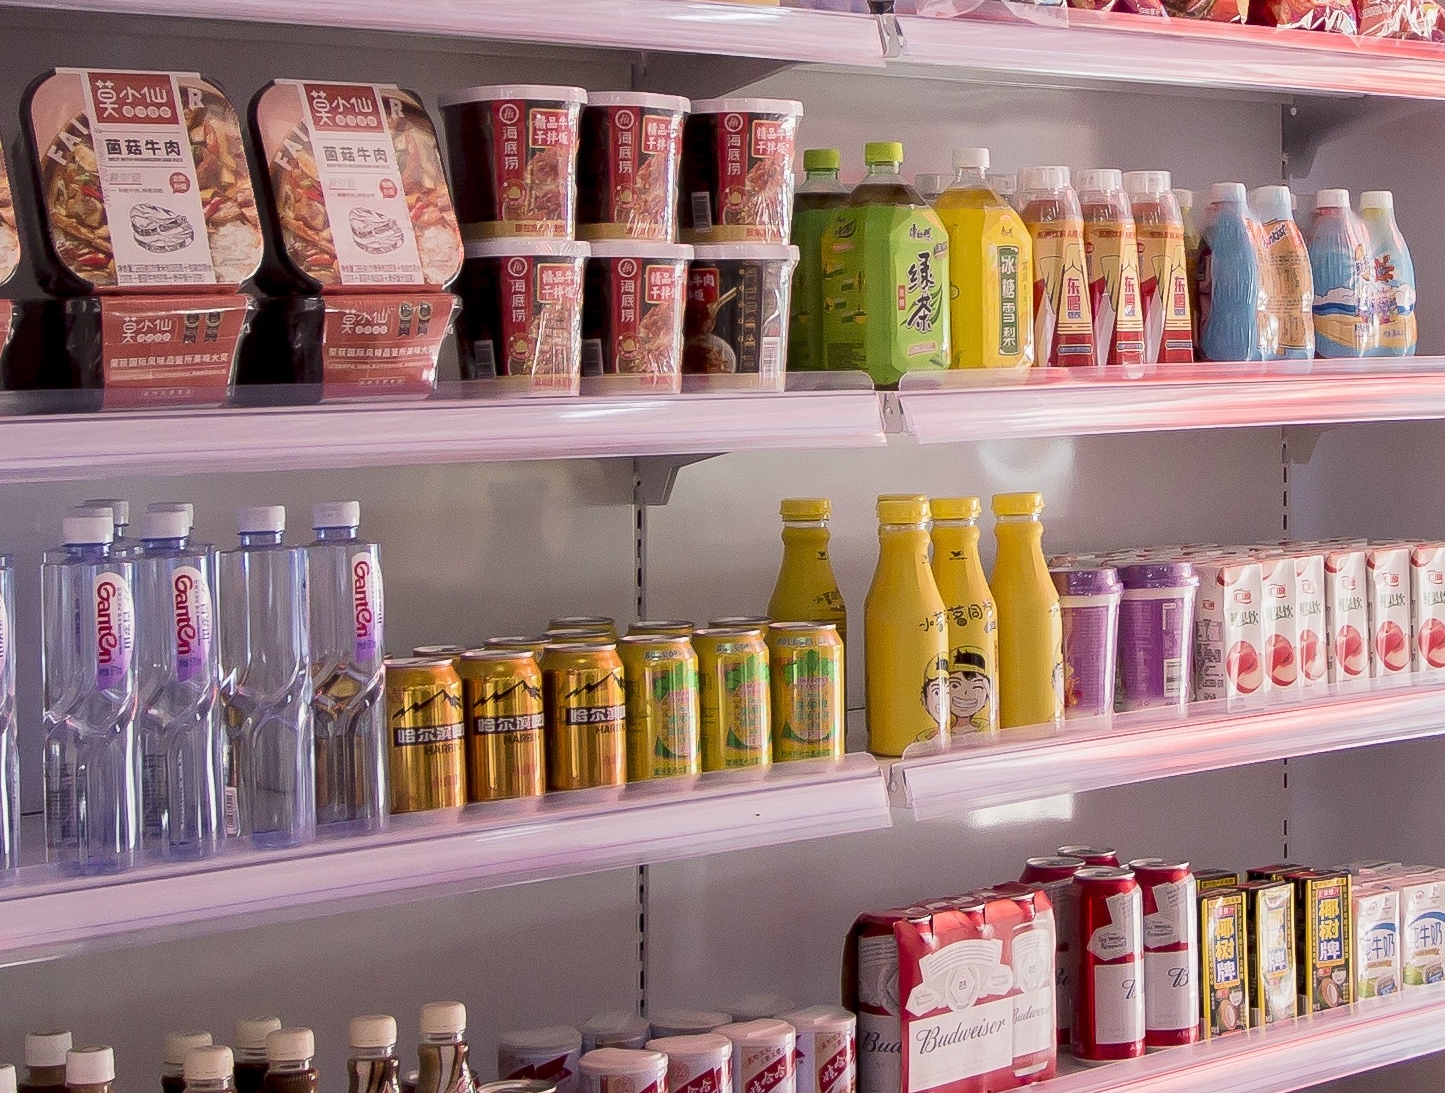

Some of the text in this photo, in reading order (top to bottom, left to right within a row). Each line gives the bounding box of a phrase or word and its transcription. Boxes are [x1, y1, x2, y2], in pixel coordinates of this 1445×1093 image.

[96, 80, 168, 117] 莫小仙
[311, 90, 372, 125] 莫小仙
[105, 138, 181, 156] 菌菇牛肉
[323, 146, 388, 163] 菌菇牛肉
[502, 126, 519, 171] 海底捞
[618, 131, 633, 175] 海底捞
[726, 134, 741, 176] 海底捞
[510, 279, 526, 323] 海底捞
[620, 279, 635, 323] 海底捞
[906, 252, 935, 334] 绿茶
[1000, 255, 1016, 347] 冰糖雪梨
[122, 316, 172, 343] 莫小仙
[341, 308, 388, 334] 莫小仙
[1215, 916, 1237, 983] 椰树牌
[1318, 898, 1343, 963] 椰树牌
[916, 1018, 1007, 1055] Budweiser
